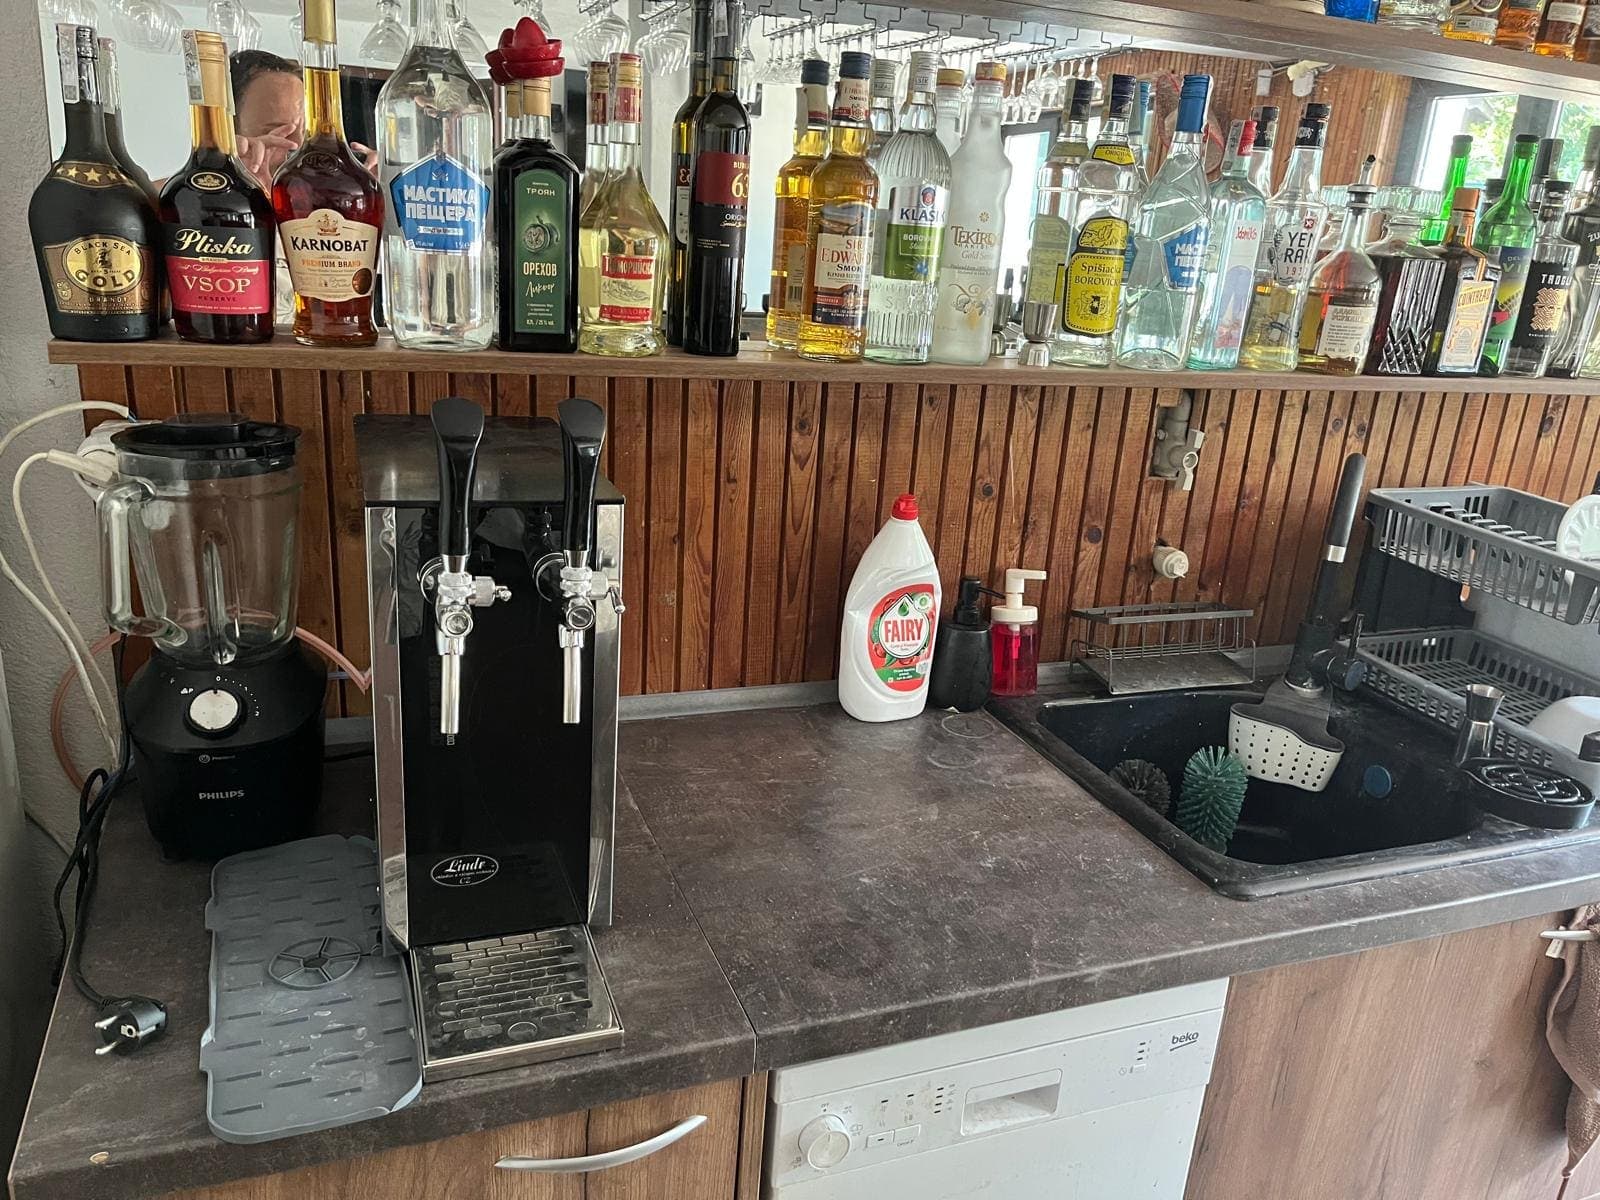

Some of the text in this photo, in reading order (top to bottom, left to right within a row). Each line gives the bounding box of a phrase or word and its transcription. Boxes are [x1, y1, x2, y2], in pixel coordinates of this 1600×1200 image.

[403, 184, 477, 205] МАСТИКА
[526, 187, 555, 196] ТРОЯН
[405, 202, 477, 223] ПЕЩЕРА
[74, 241, 132, 256] BLACK SEA
[174, 228, 254, 254] Pliska
[290, 235, 369, 252] KARNOBAT
[845, 239, 864, 250] SIR
[301, 259, 336, 268] PREMIUM
[523, 261, 557, 277] ОРЕХОВ
[74, 269, 136, 289] GOLD
[182, 274, 252, 293] VSOP
[88, 296, 128, 304] BRANDY
[1456, 284, 1494, 308] COINTREAU
[884, 618, 924, 643] FAIRY
[198, 789, 246, 800] PHILIPS
[444, 857, 486, 873] Lindr
[1171, 1031, 1200, 1045] beko
